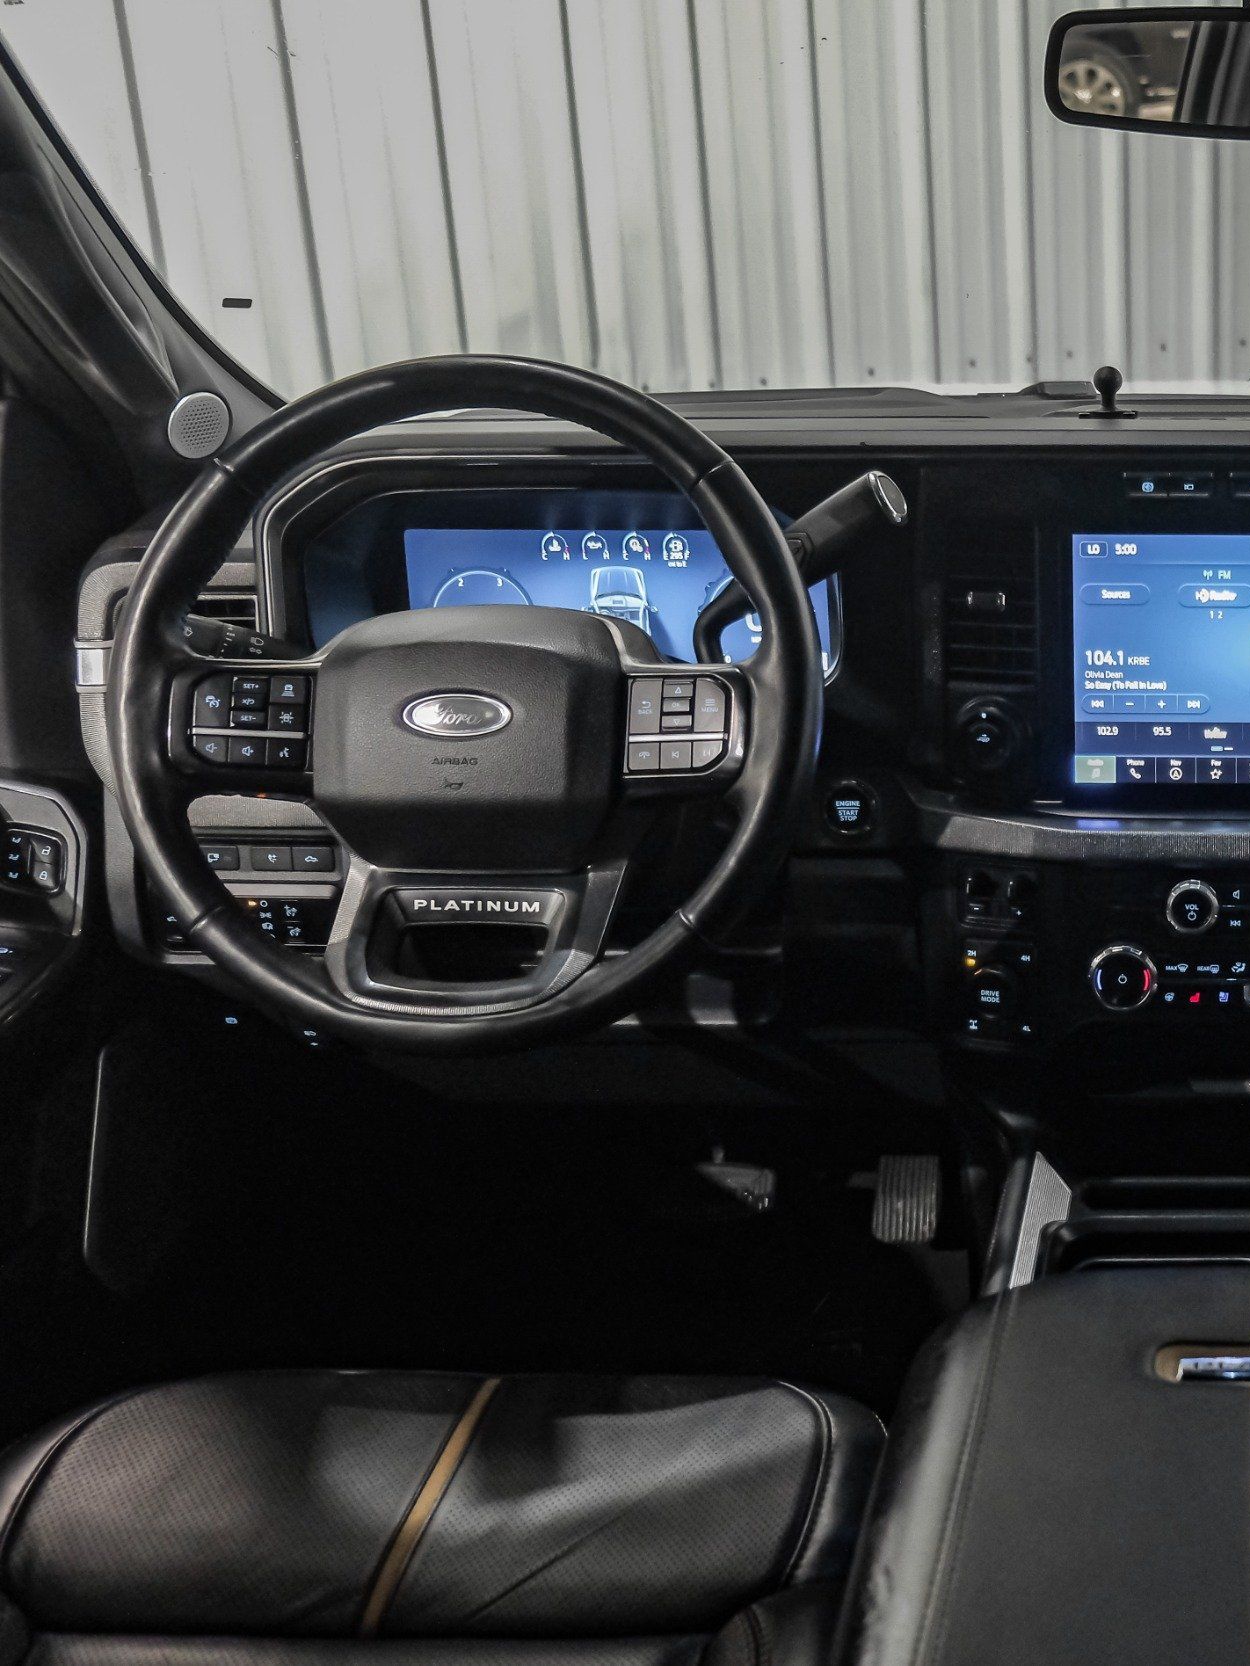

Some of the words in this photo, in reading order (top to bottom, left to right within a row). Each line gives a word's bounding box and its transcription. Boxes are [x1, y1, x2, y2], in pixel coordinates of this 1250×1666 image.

[1217, 570, 1231, 580] FM
[458, 577, 464, 587] 2
[1101, 589, 1131, 600] Sources
[1085, 650, 1124, 666] 104.1
[1127, 656, 1150, 666] KRBE
[1084, 670, 1104, 679] Olivia
[1105, 671, 1123, 679] Dean
[1097, 726, 1118, 736] 102.9
[1153, 727, 1172, 736] 95.5
[431, 757, 478, 766] AIRBAG
[1126, 759, 1145, 767] Phone
[413, 899, 541, 913] PLATINUM
[1184, 903, 1200, 911] VOL
[967, 949, 977, 957] 2H
[980, 989, 1000, 997] DRIVE
[980, 995, 1001, 1003] MODE
